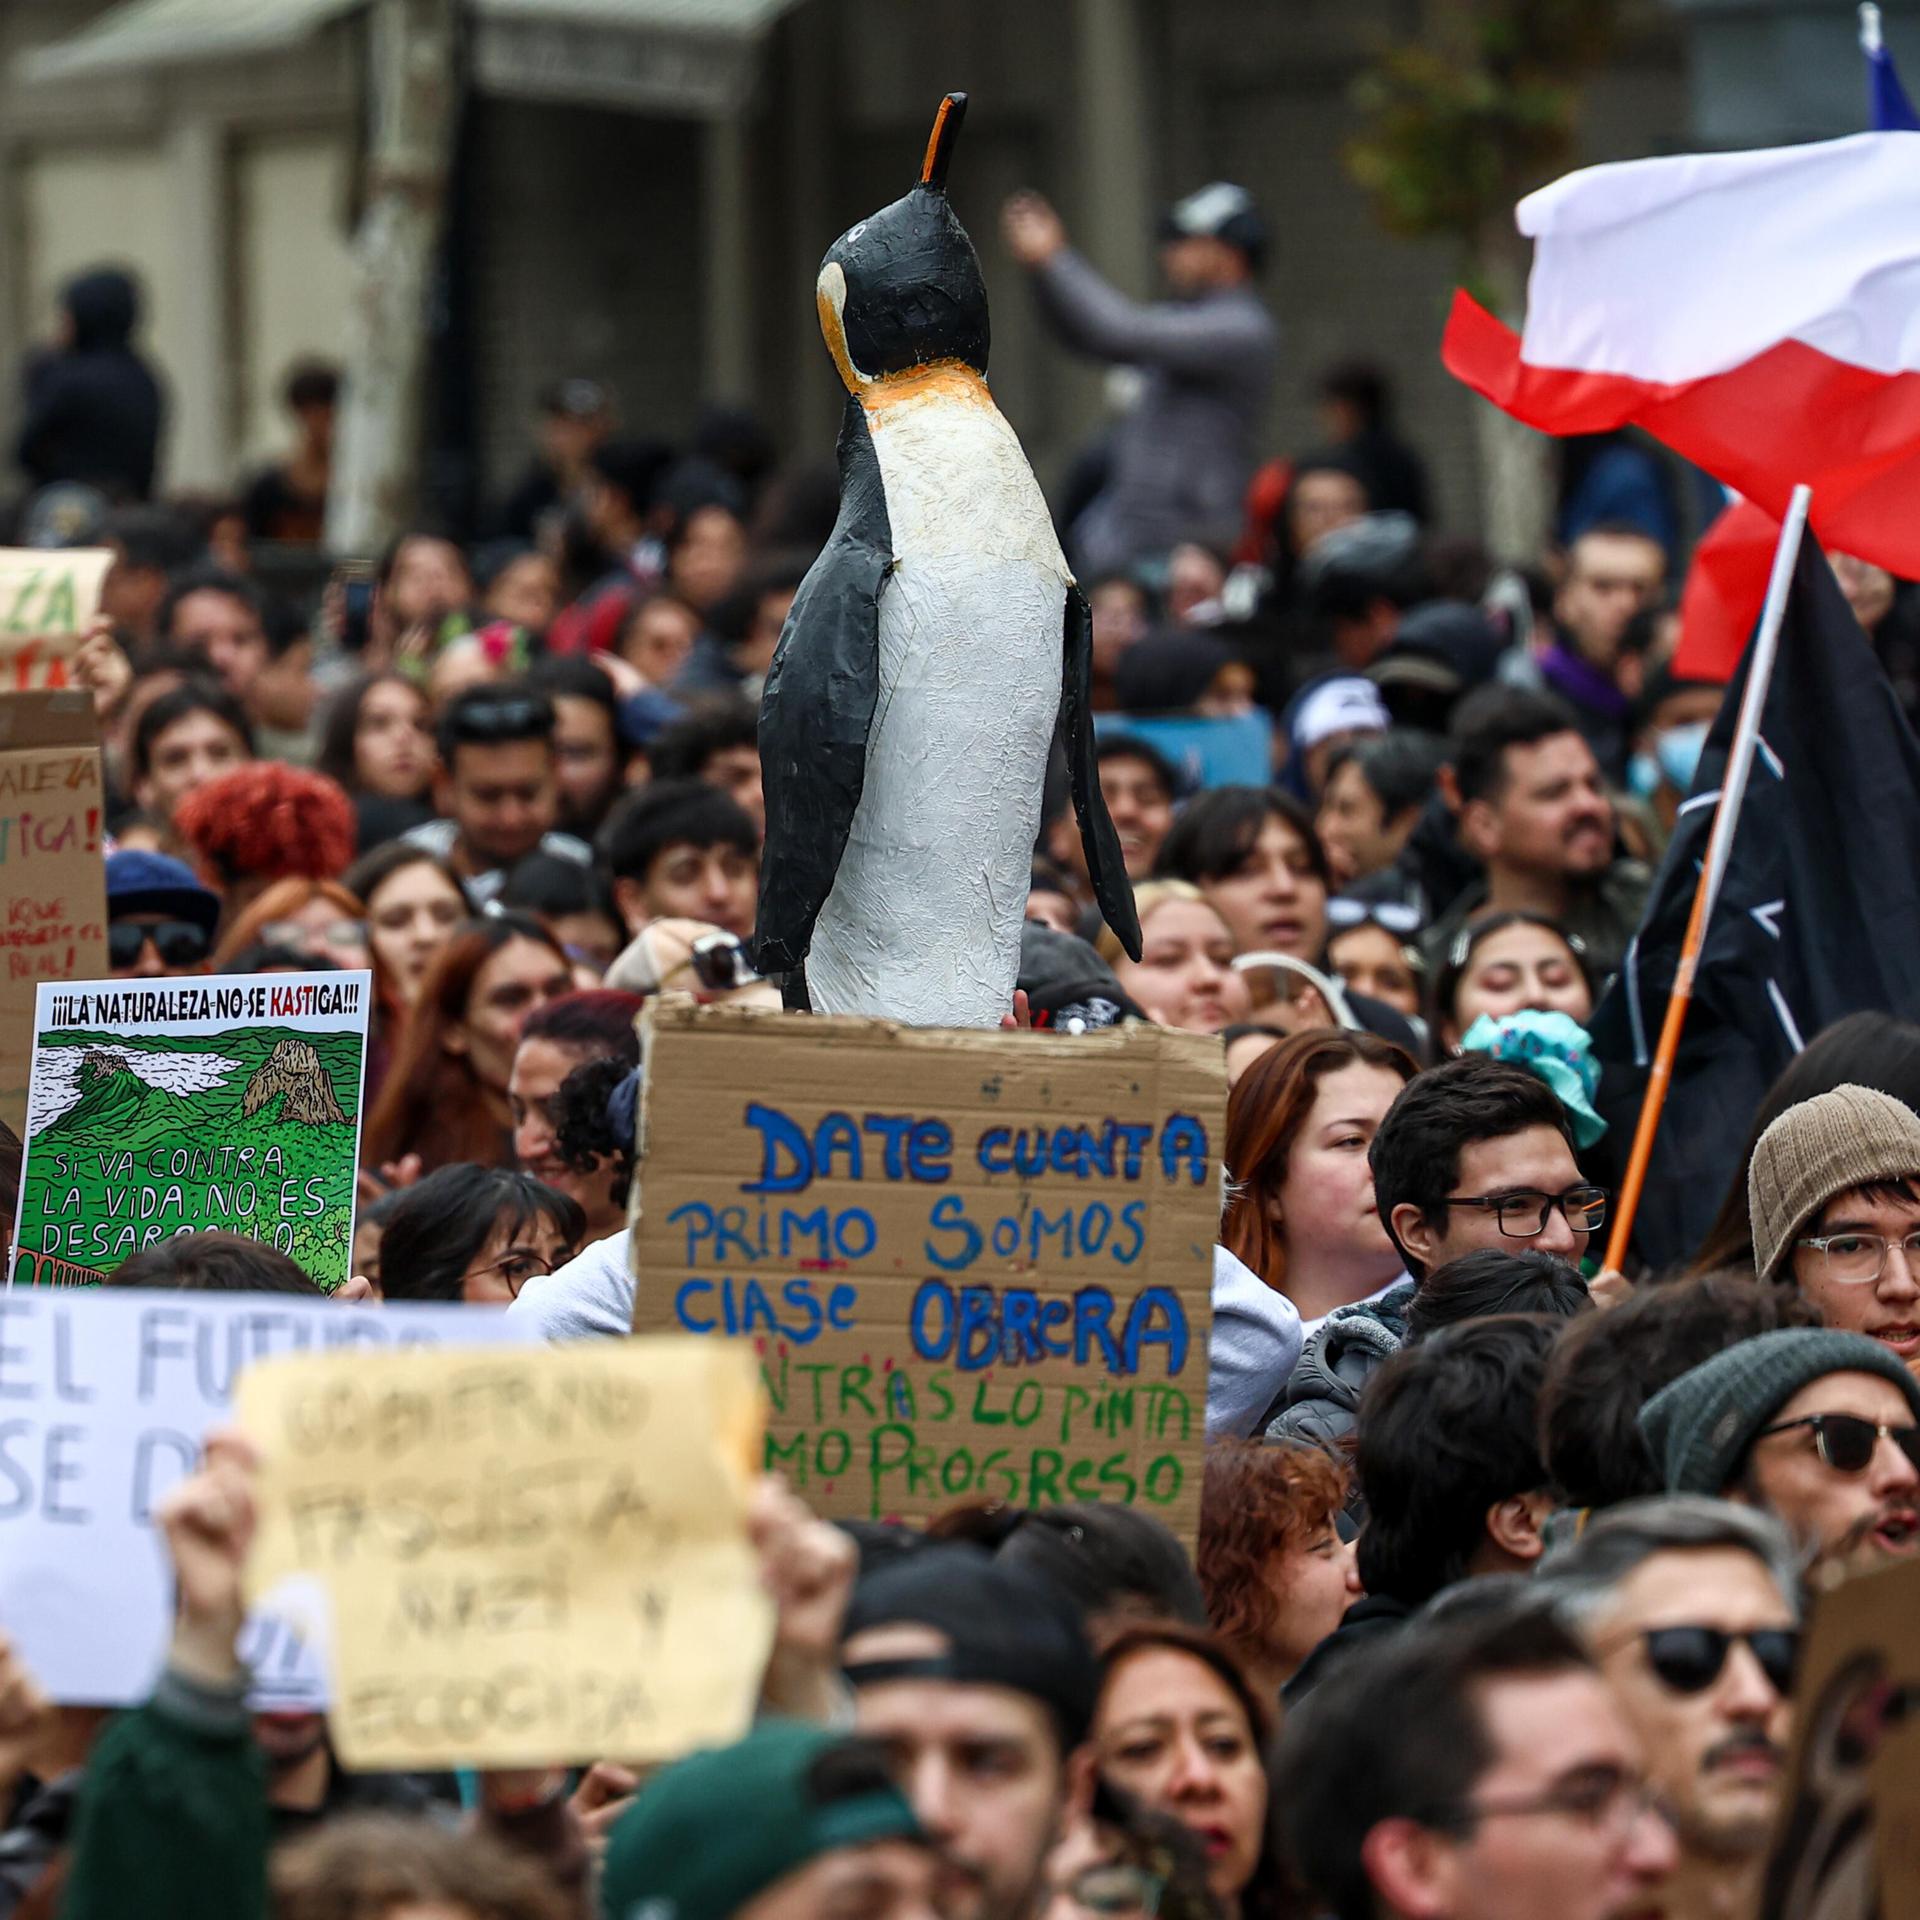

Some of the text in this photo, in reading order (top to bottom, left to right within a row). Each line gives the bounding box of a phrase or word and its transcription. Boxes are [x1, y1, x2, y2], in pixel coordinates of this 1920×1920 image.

[95, 989, 211, 1025] NATURALEZA
[216, 988, 243, 1019] NO
[248, 987, 266, 1018] SE
[270, 984, 359, 1017] KASTIGA!!!
[98, 1150, 135, 1182] VA
[148, 1145, 284, 1180] CONTRA
[42, 1187, 82, 1216] LA
[205, 1181, 257, 1218] NO
[279, 1176, 326, 1217] ES
[970, 1377, 1043, 1429] LO
